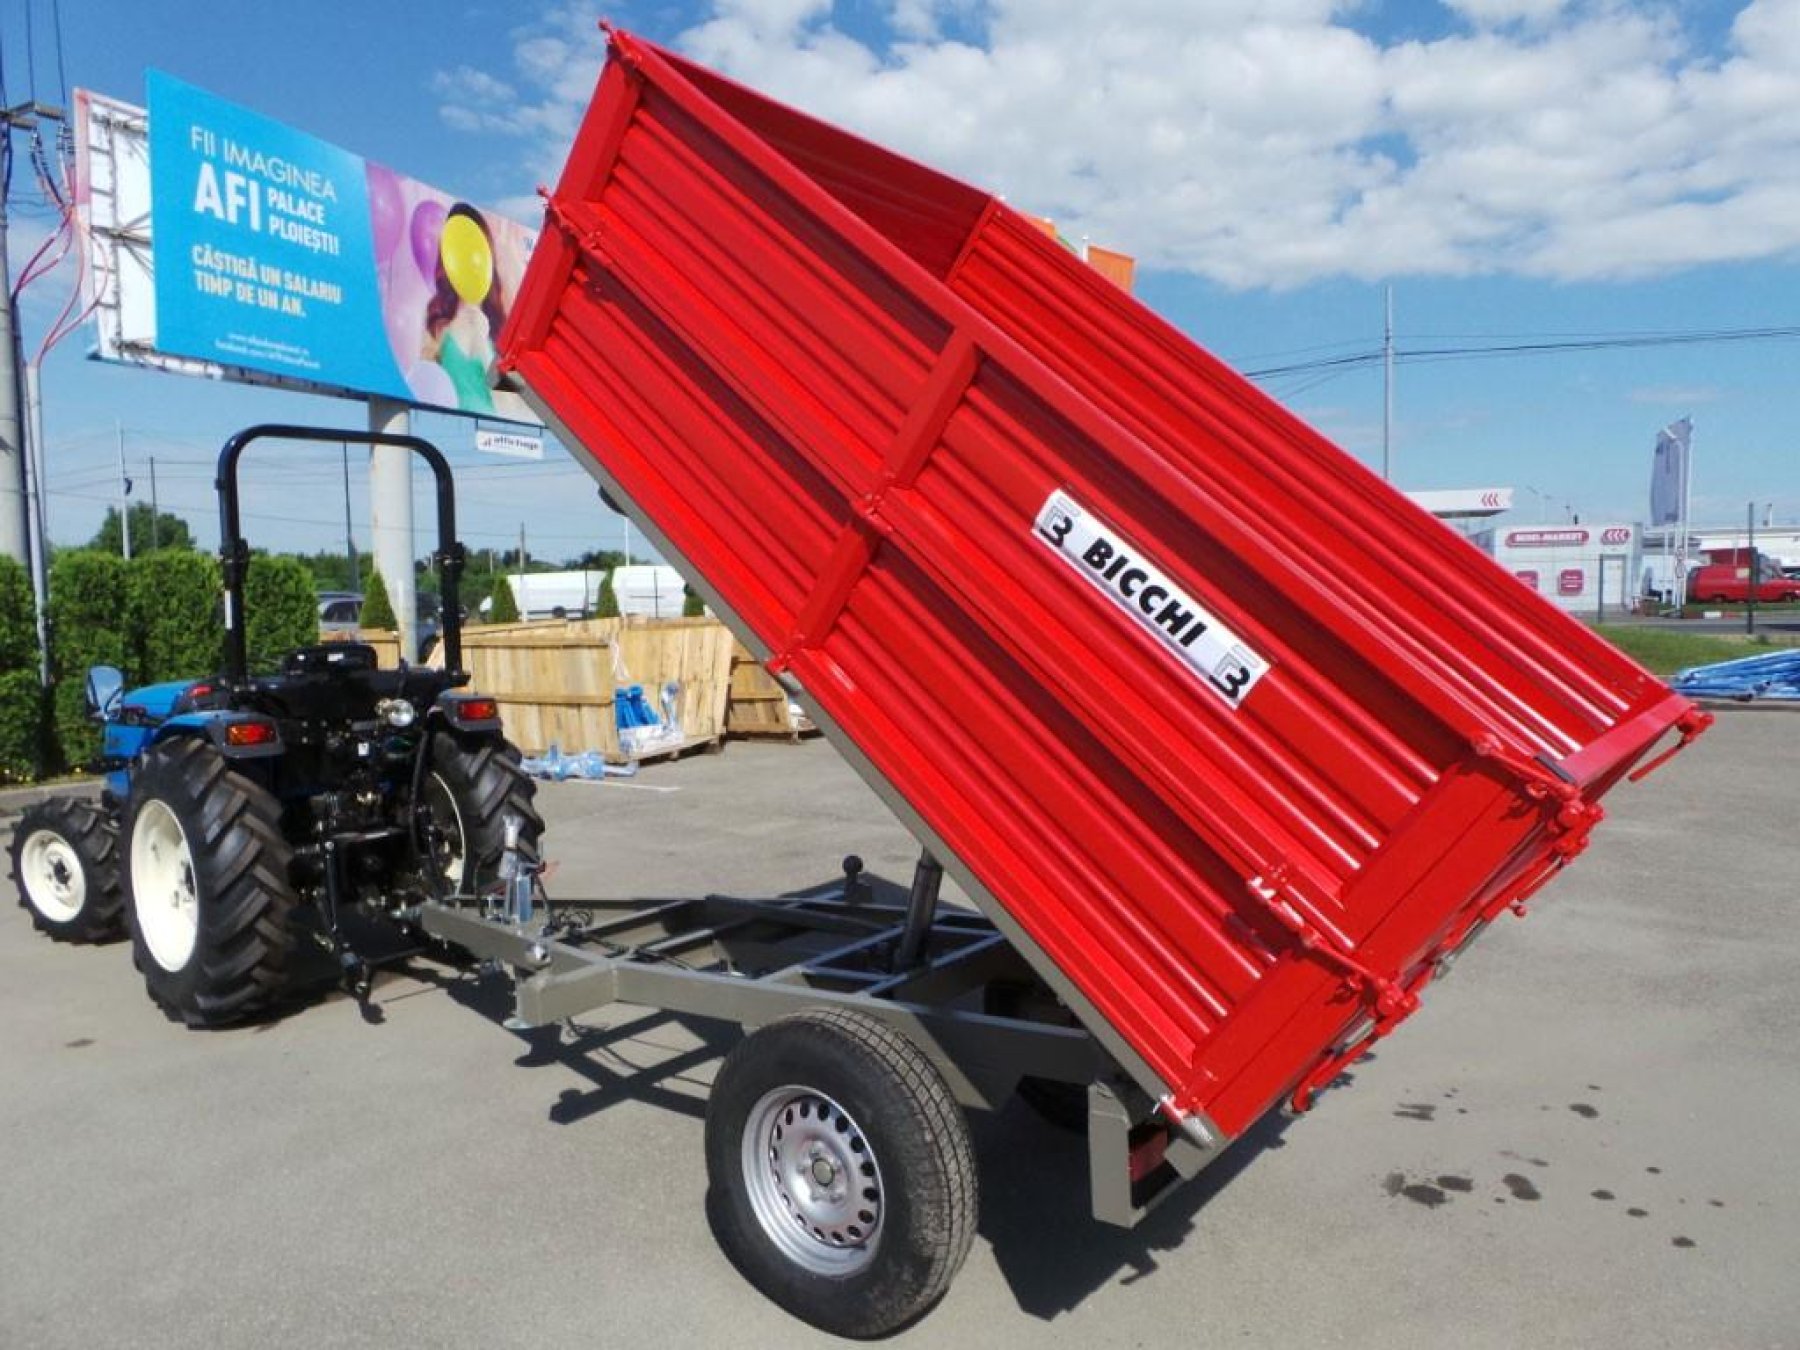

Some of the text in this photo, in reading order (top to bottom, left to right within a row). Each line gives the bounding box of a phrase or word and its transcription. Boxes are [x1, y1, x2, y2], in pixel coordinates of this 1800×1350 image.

[191, 126, 338, 203] FII IMAGINEA
[194, 161, 261, 232] AFI
[267, 187, 326, 225] PALACE
[194, 269, 233, 297] TIMP
[236, 281, 255, 305] DE
[257, 288, 278, 311] UN
[259, 264, 282, 287] UN
[283, 271, 342, 305] SALARIU
[1082, 537, 1207, 647] BICCHI
